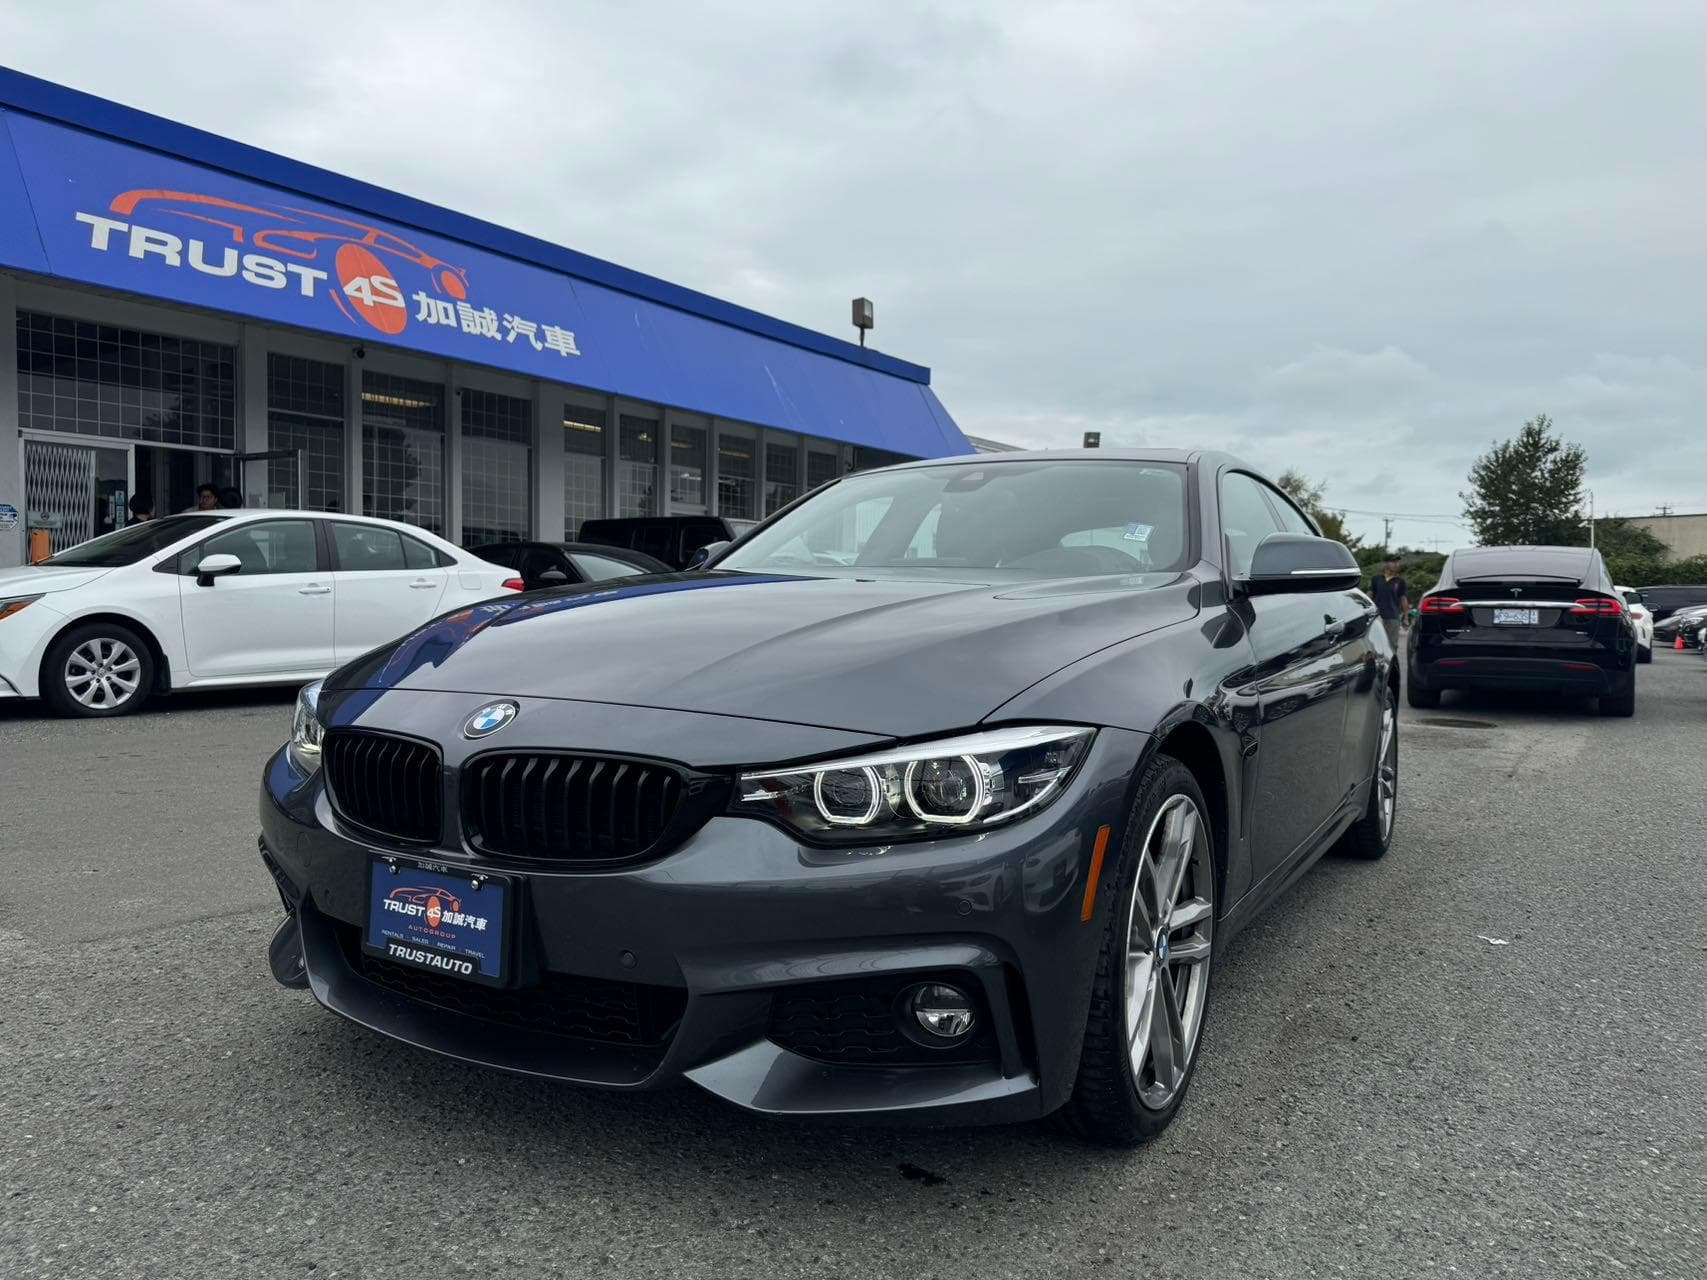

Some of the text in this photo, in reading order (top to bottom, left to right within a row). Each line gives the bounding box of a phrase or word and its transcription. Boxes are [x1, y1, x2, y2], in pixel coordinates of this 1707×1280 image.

[75, 211, 581, 357] TRUST 4S 加誠汽車
[383, 899, 488, 930] TRUST 4S 加誠汽車
[408, 925, 456, 939] AUTOGROUP
[388, 944, 473, 974] TRUSTAUTO
